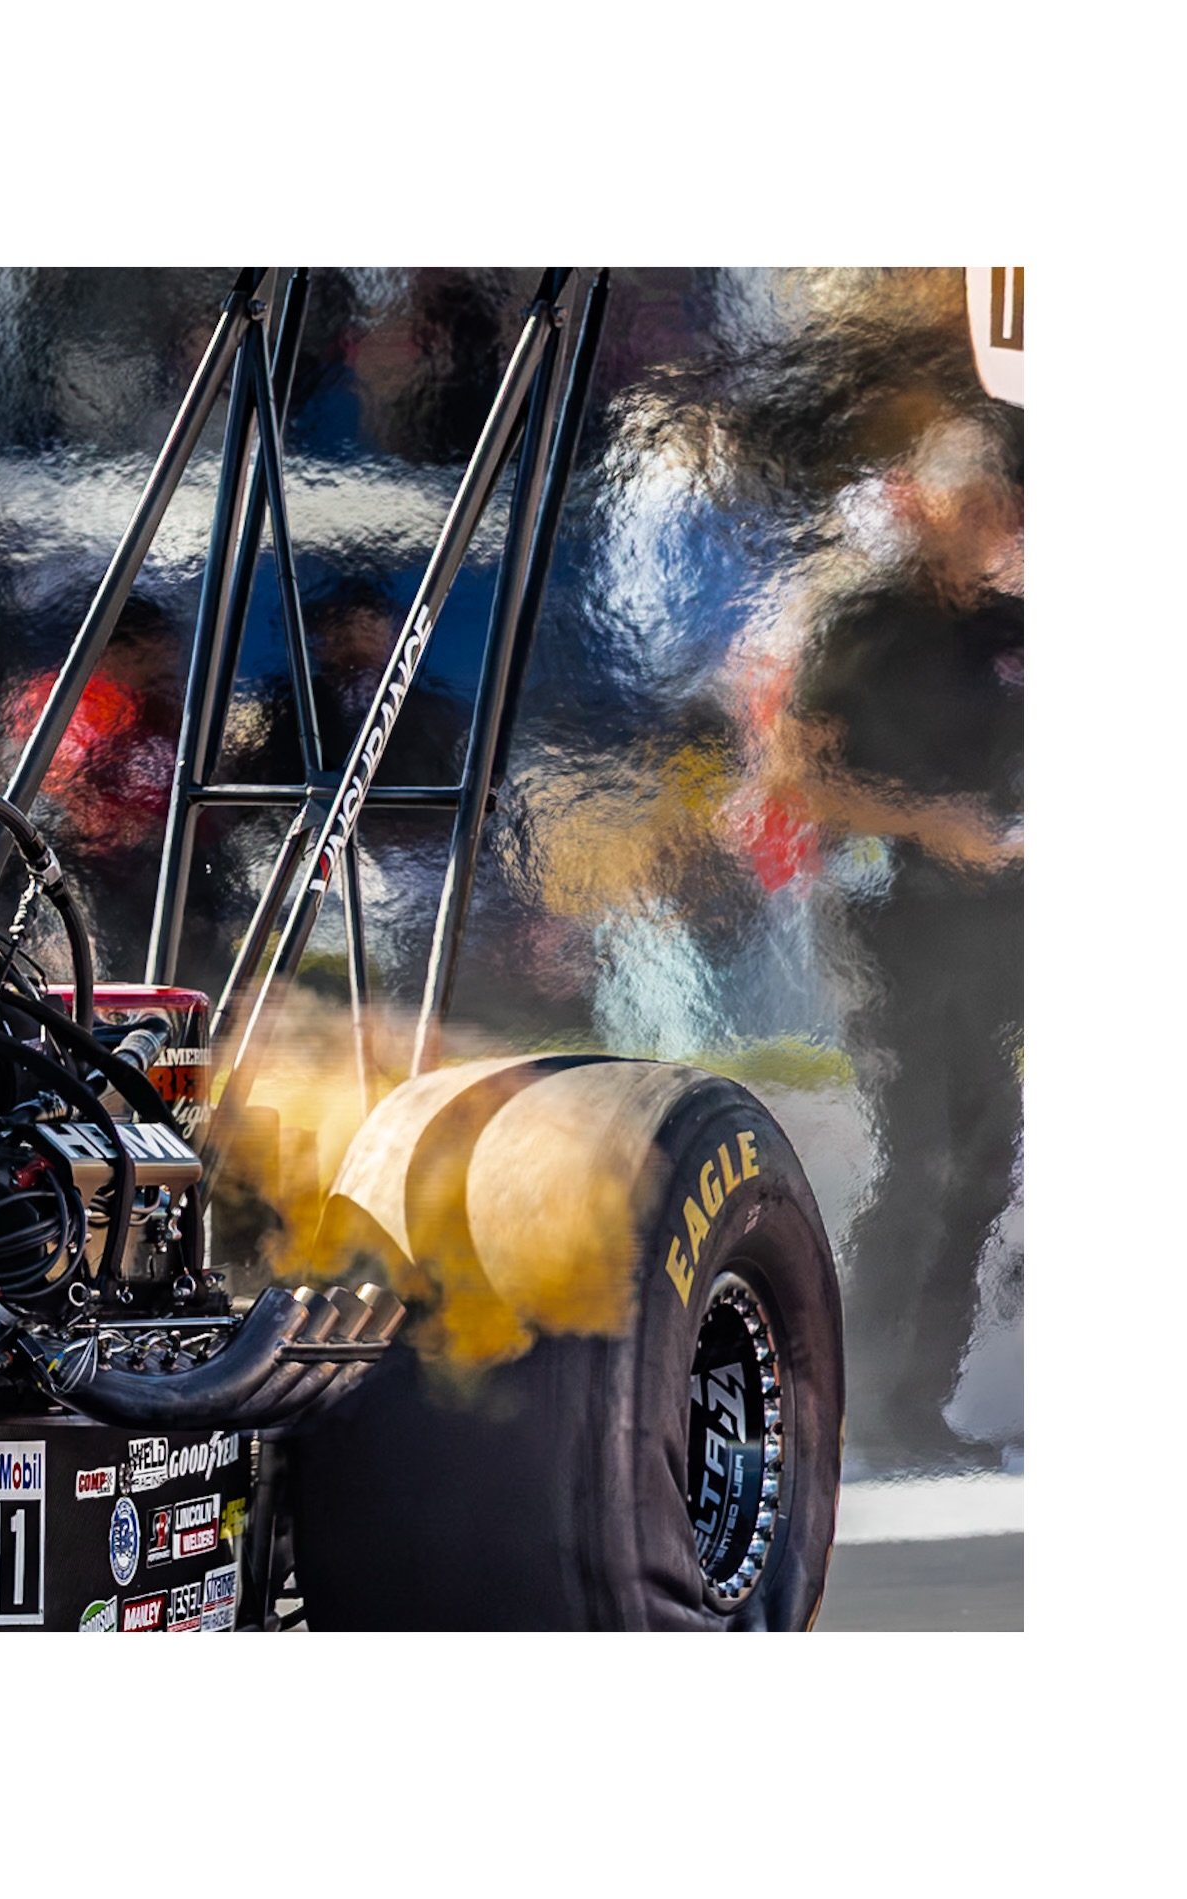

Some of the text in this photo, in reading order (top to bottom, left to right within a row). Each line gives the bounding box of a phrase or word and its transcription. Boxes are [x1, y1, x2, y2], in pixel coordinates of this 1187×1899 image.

[36, 1122, 196, 1159] HEMI
[665, 1130, 761, 1308] EAGLE
[0, 1453, 42, 1491] Mobil
[78, 1472, 107, 1493] COMP
[175, 1501, 214, 1531] LINCOLN
[10, 1508, 26, 1606] 1
[183, 1529, 215, 1552] WELDERS
